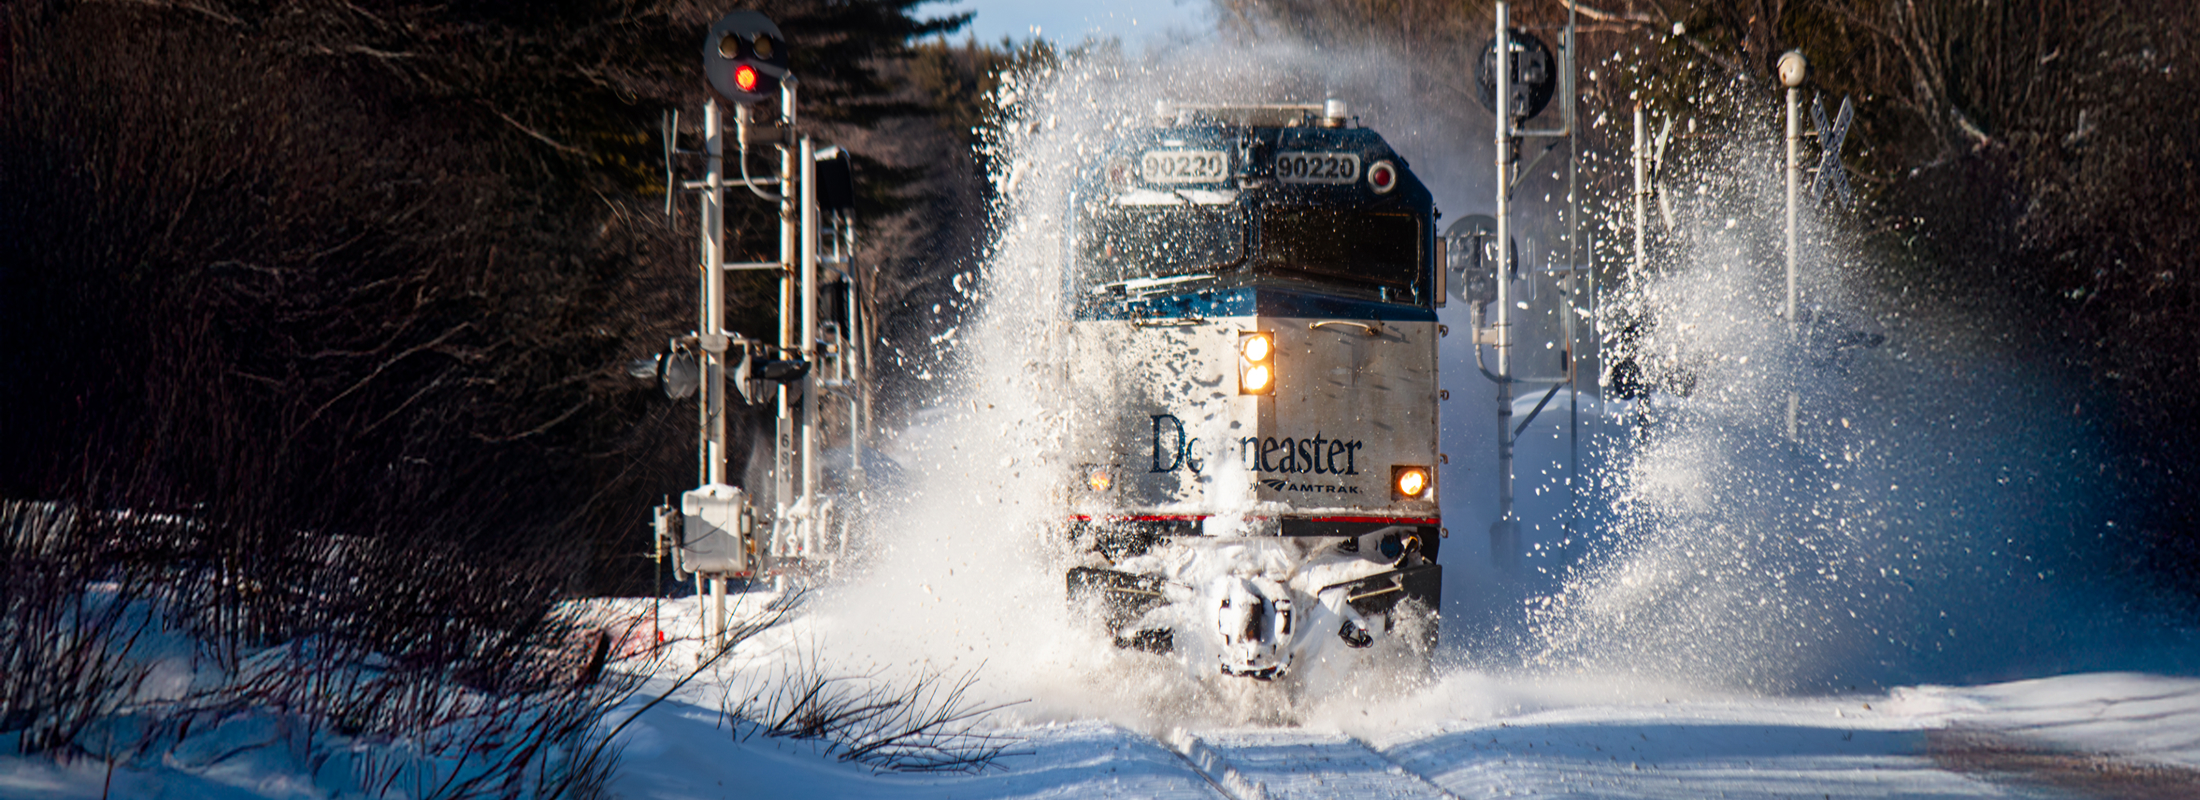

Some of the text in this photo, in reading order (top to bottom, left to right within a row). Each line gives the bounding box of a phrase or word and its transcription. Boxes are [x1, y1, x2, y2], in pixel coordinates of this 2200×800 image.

[1145, 156, 1223, 178] 90220
[1278, 156, 1355, 179] 90220
[1149, 413, 1363, 476] Doneaster
[1288, 483, 1359, 495] AMTRAK
